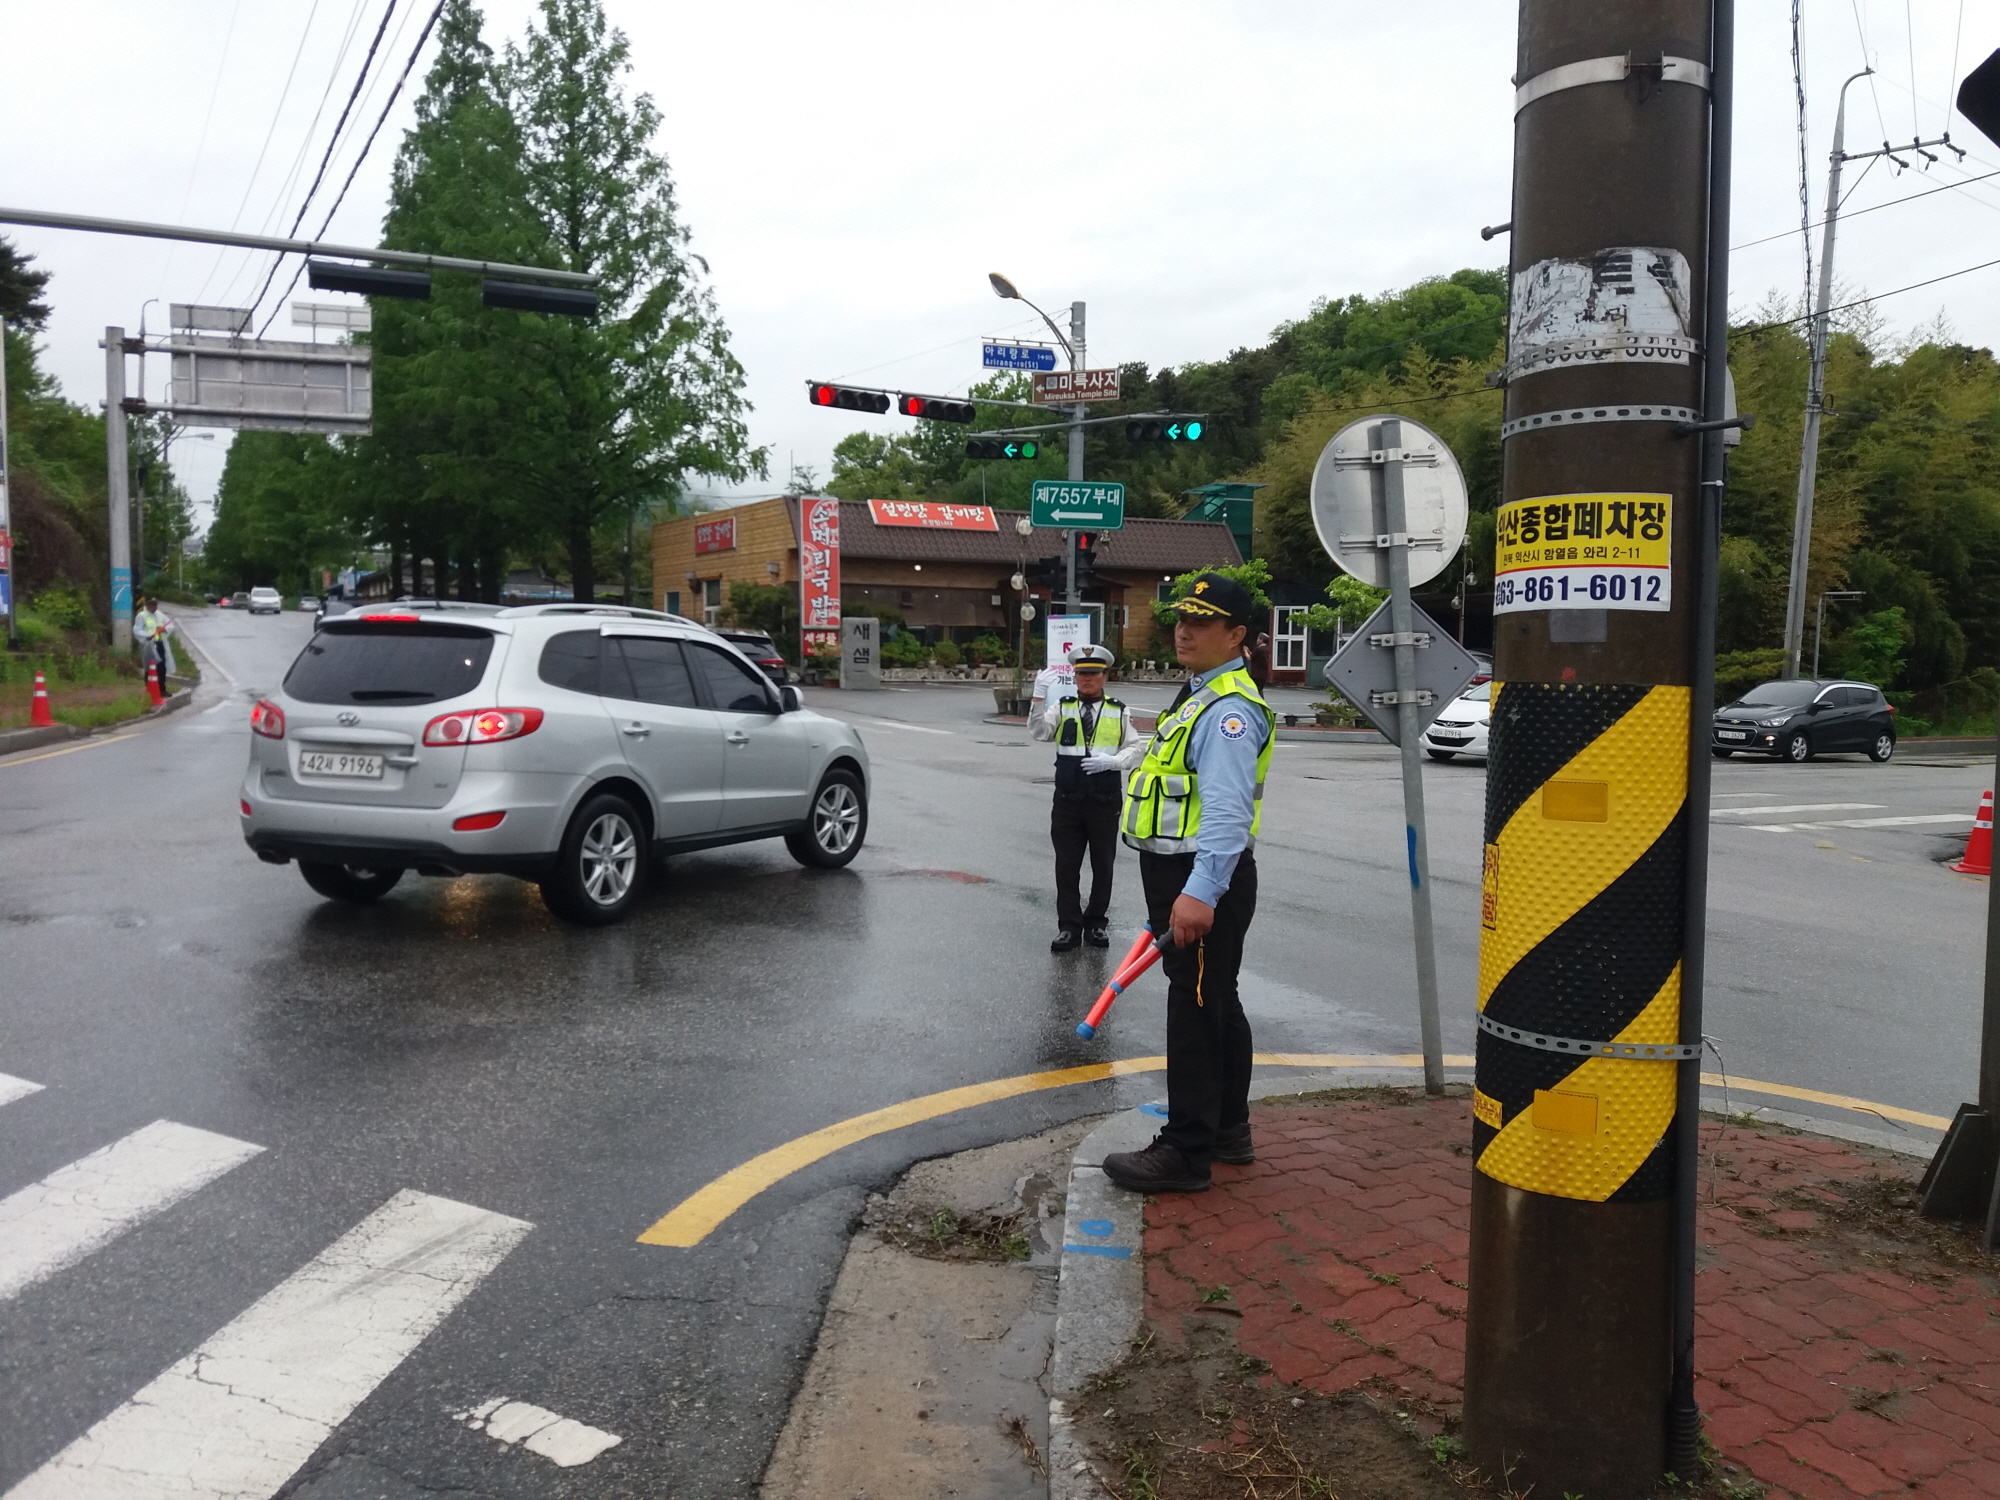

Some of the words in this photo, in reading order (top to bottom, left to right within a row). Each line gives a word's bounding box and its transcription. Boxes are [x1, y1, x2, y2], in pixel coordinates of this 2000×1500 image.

[985, 346, 1030, 360] 아리랑로
[985, 358, 1039, 369] Arirang-ro(St)
[1059, 370, 1118, 391] 미륵사지
[1044, 392, 1076, 400] Mireuksa
[1076, 390, 1102, 399] Temple
[1103, 388, 1118, 397] Site
[937, 505, 985, 522] 갈비탕
[1498, 501, 1667, 549] 익산종합폐차장
[811, 504, 834, 620] 소머리국밥
[1515, 549, 1540, 565] 익산시
[1544, 547, 1579, 561] 함열읍
[1583, 546, 1608, 560] 와리
[1613, 547, 1641, 559] 2-11
[339, 756, 374, 774] 9196
